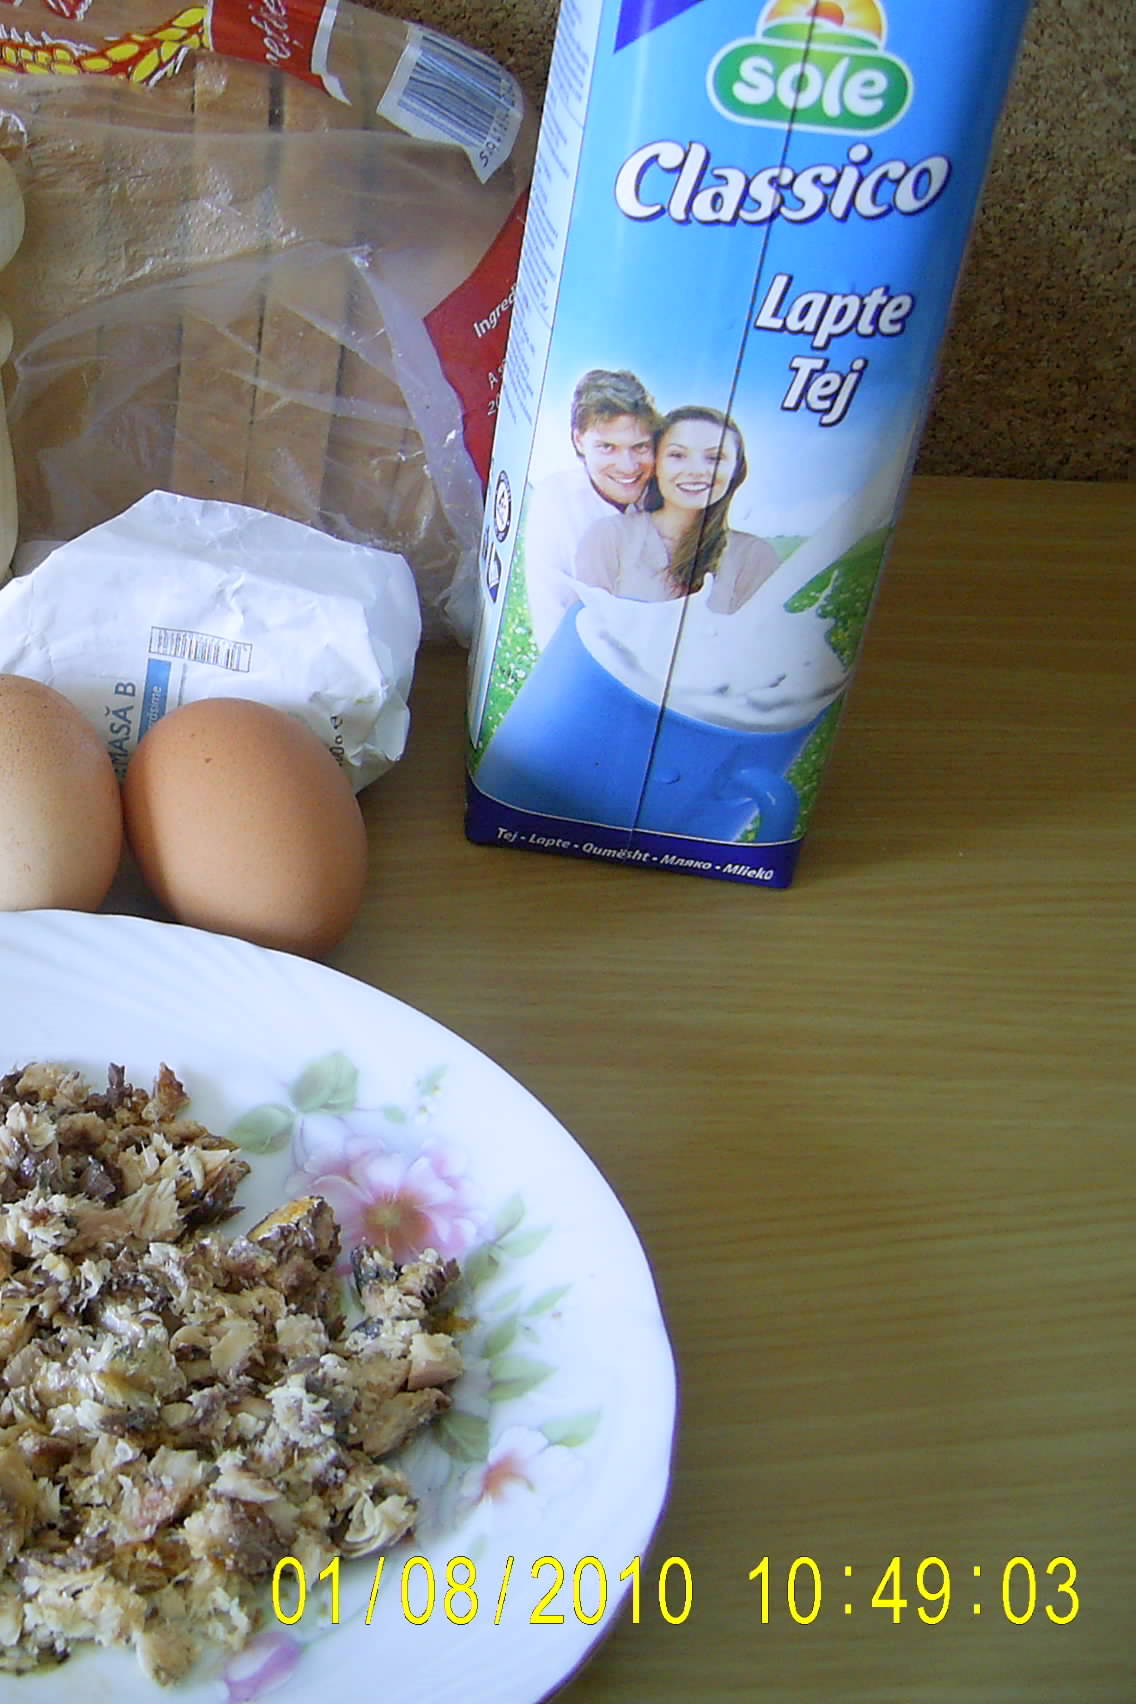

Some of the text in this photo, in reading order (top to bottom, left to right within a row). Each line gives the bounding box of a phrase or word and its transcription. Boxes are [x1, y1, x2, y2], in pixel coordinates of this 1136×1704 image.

[731, 55, 888, 118] sole
[614, 140, 952, 227] Classico
[472, 281, 517, 339] Ingred
[755, 272, 914, 350] Lapte
[781, 355, 867, 429] Tej
[496, 826, 519, 844] Tej
[528, 832, 571, 850] Lapte
